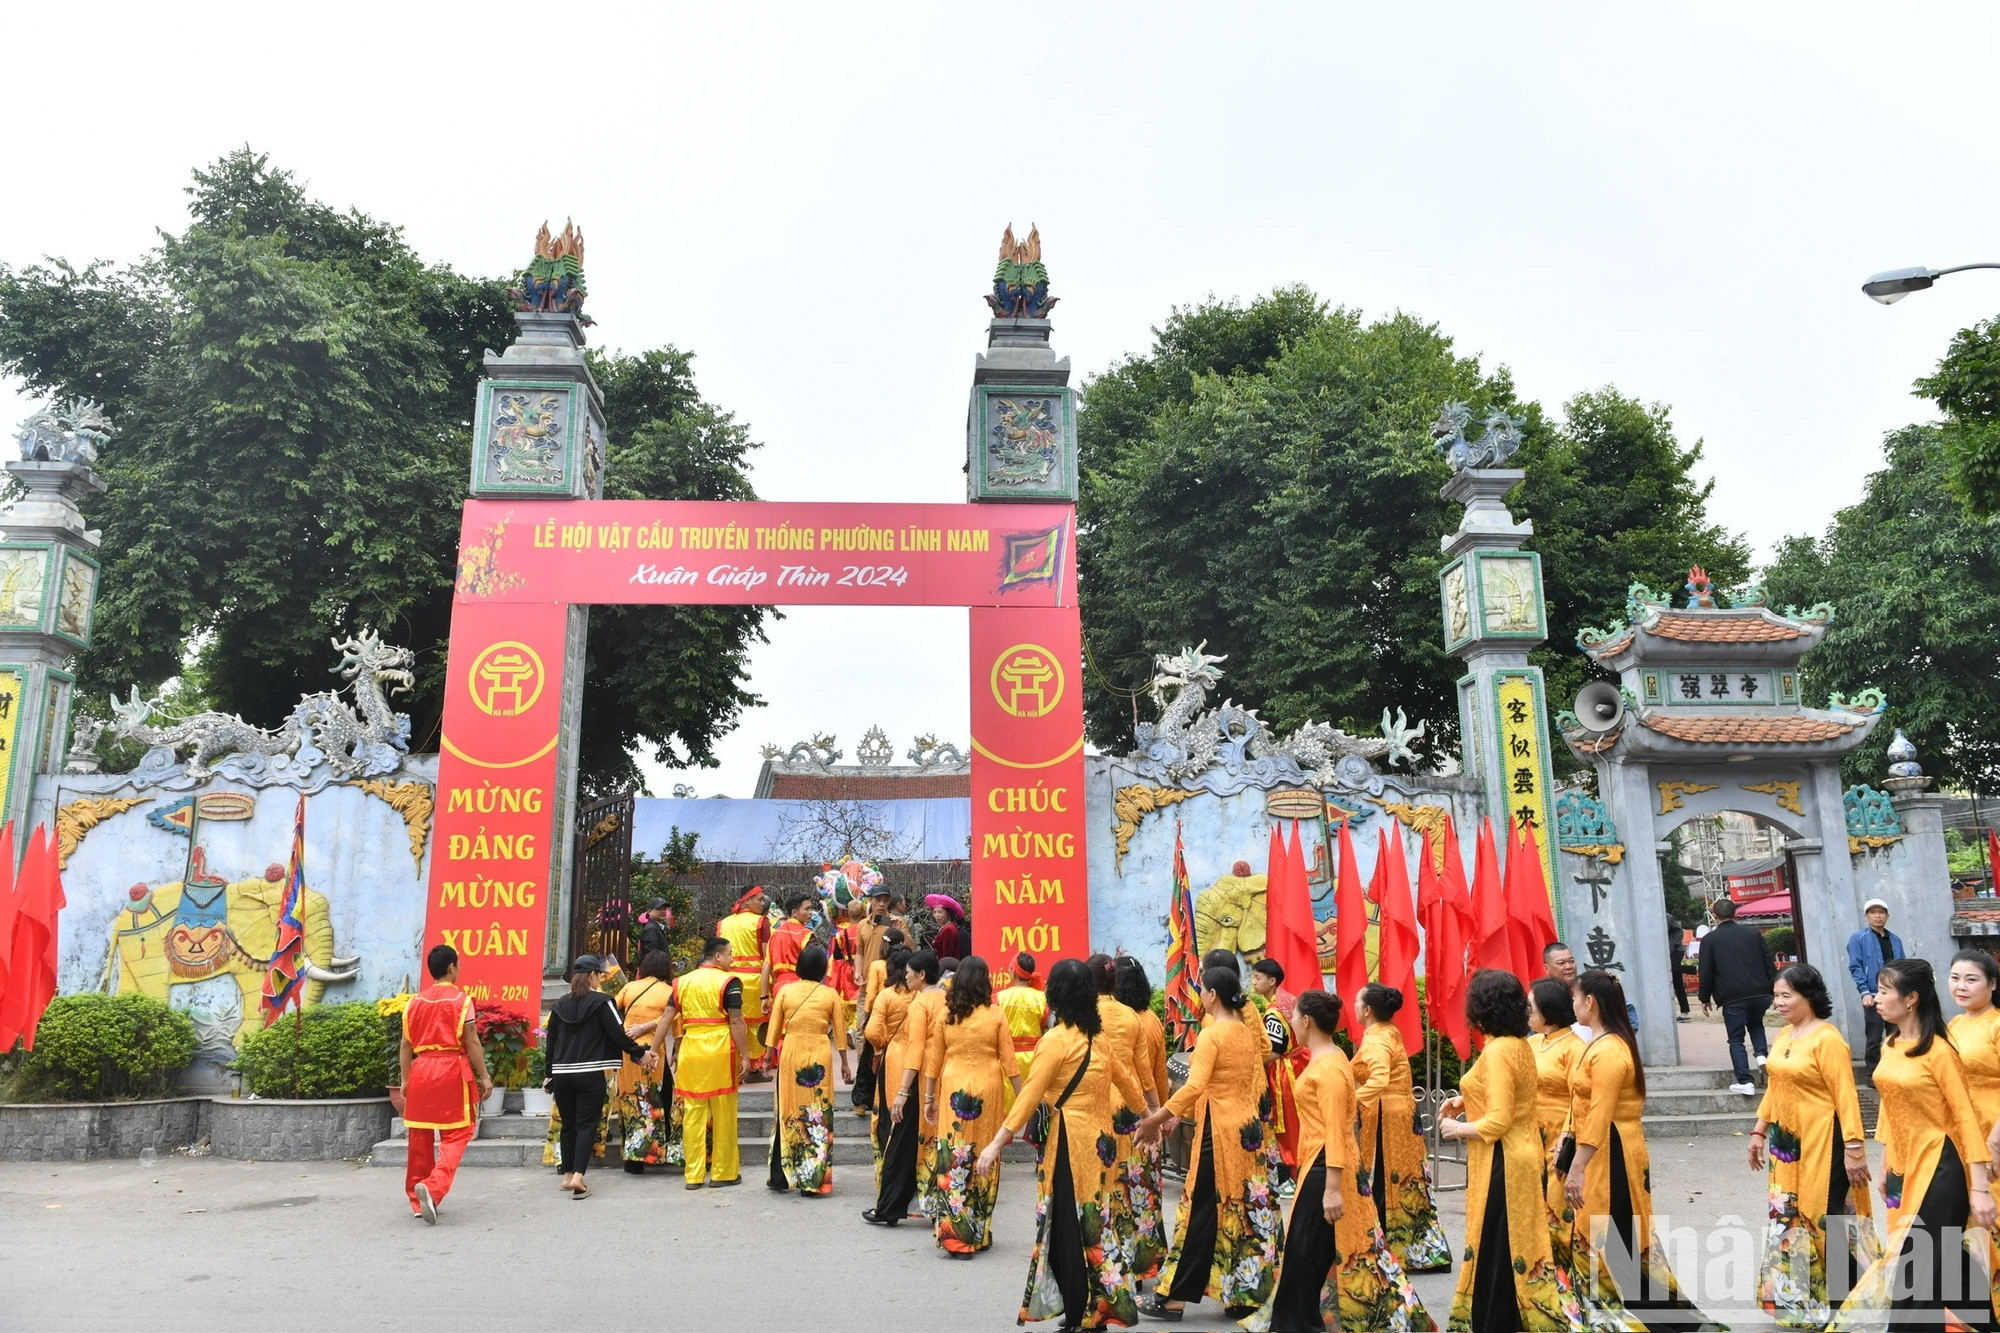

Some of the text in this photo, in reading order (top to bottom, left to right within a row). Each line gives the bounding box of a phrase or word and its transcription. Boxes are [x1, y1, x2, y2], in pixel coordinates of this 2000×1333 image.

[533, 517, 989, 553] LỄ HỘI VẬT CẦU TRUYỀN THỐNG PHƯỜNG LĨNH NAM
[628, 563, 908, 591] Xuân Giáp Thìn 2024
[446, 780, 543, 813] MỪNG
[988, 779, 1068, 813] CHÚC
[448, 826, 535, 860] ĐẢNG
[982, 825, 1075, 859] MỪNG
[438, 873, 536, 908] MỪNG
[994, 872, 1066, 905] NĂM
[440, 921, 529, 956] XUÂN
[1000, 917, 1062, 952] MỚI
[501, 985, 529, 1001] 2024
